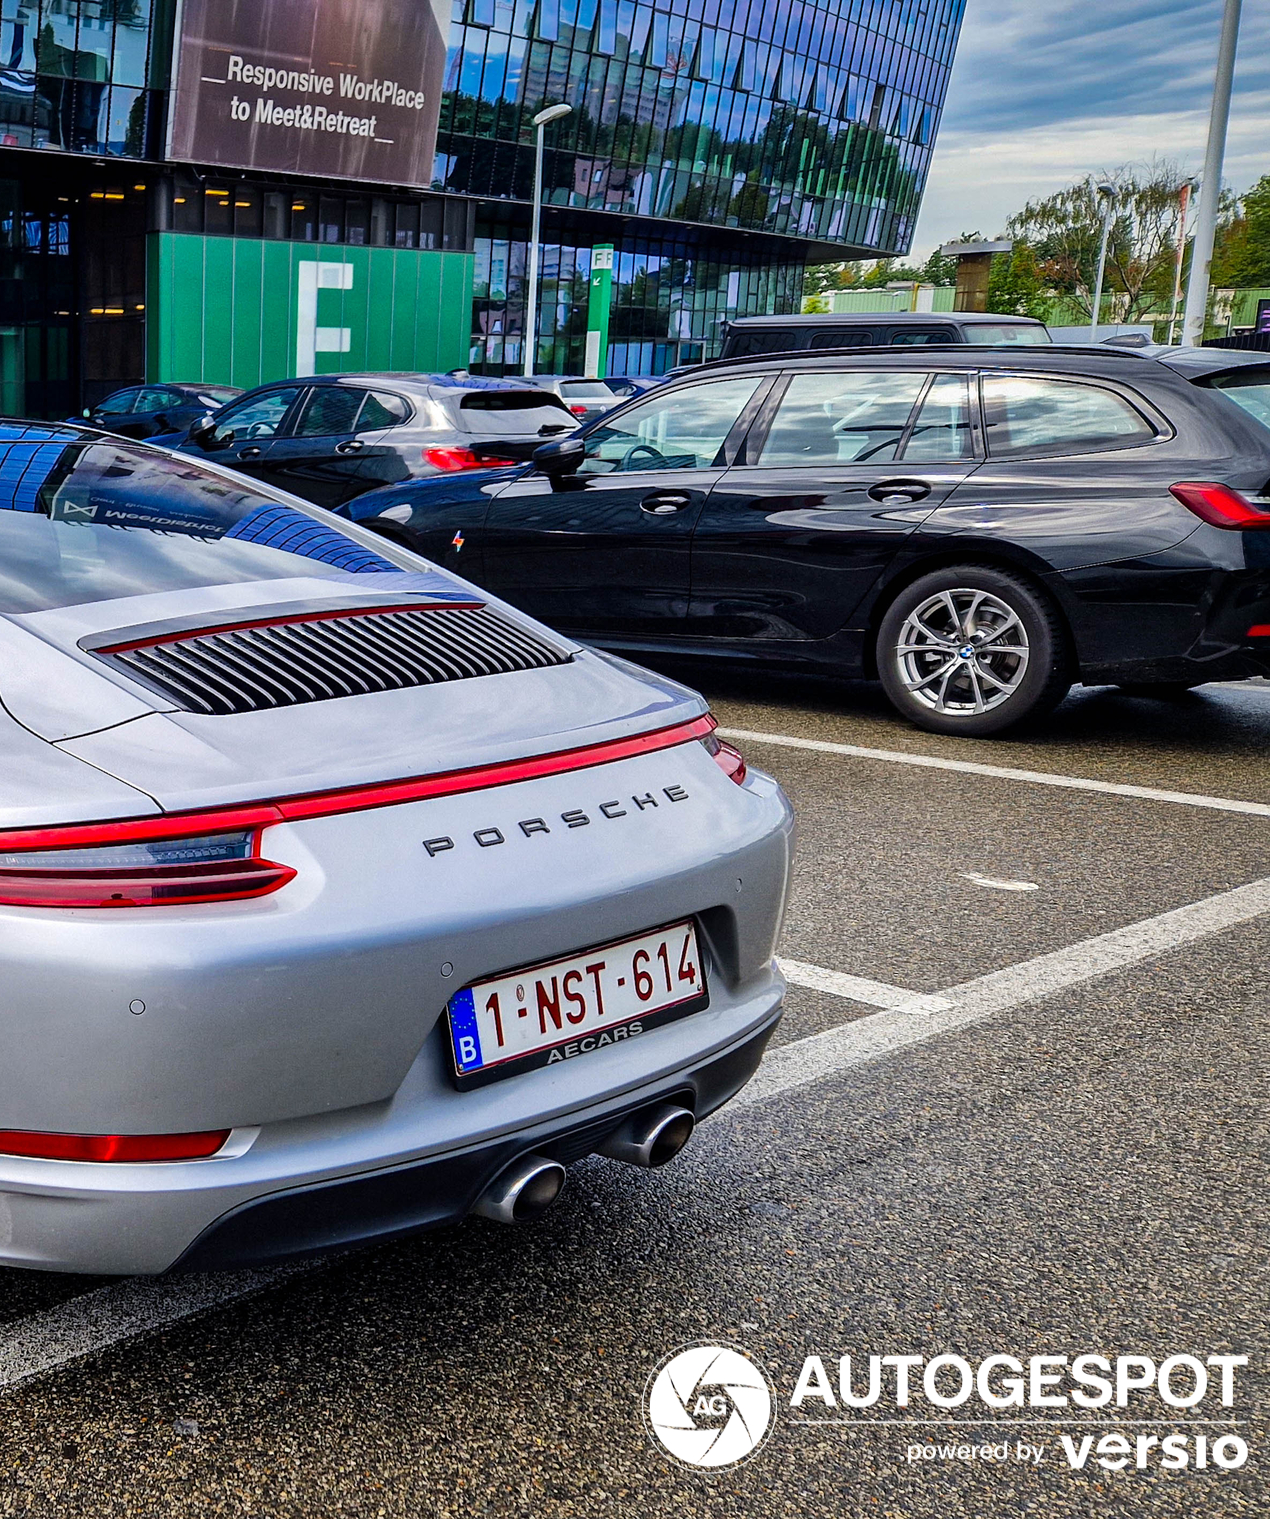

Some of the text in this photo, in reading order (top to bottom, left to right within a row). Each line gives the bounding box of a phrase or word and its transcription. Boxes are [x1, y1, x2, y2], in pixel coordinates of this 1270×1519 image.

[231, 96, 250, 121] to
[339, 73, 425, 110] WorkPlace
[595, 253, 603, 266] F
[296, 261, 353, 378] F
[422, 784, 689, 857] PORSCHE
[459, 934, 696, 1063] B 1-NST-614
[546, 1021, 644, 1064] AECARS
